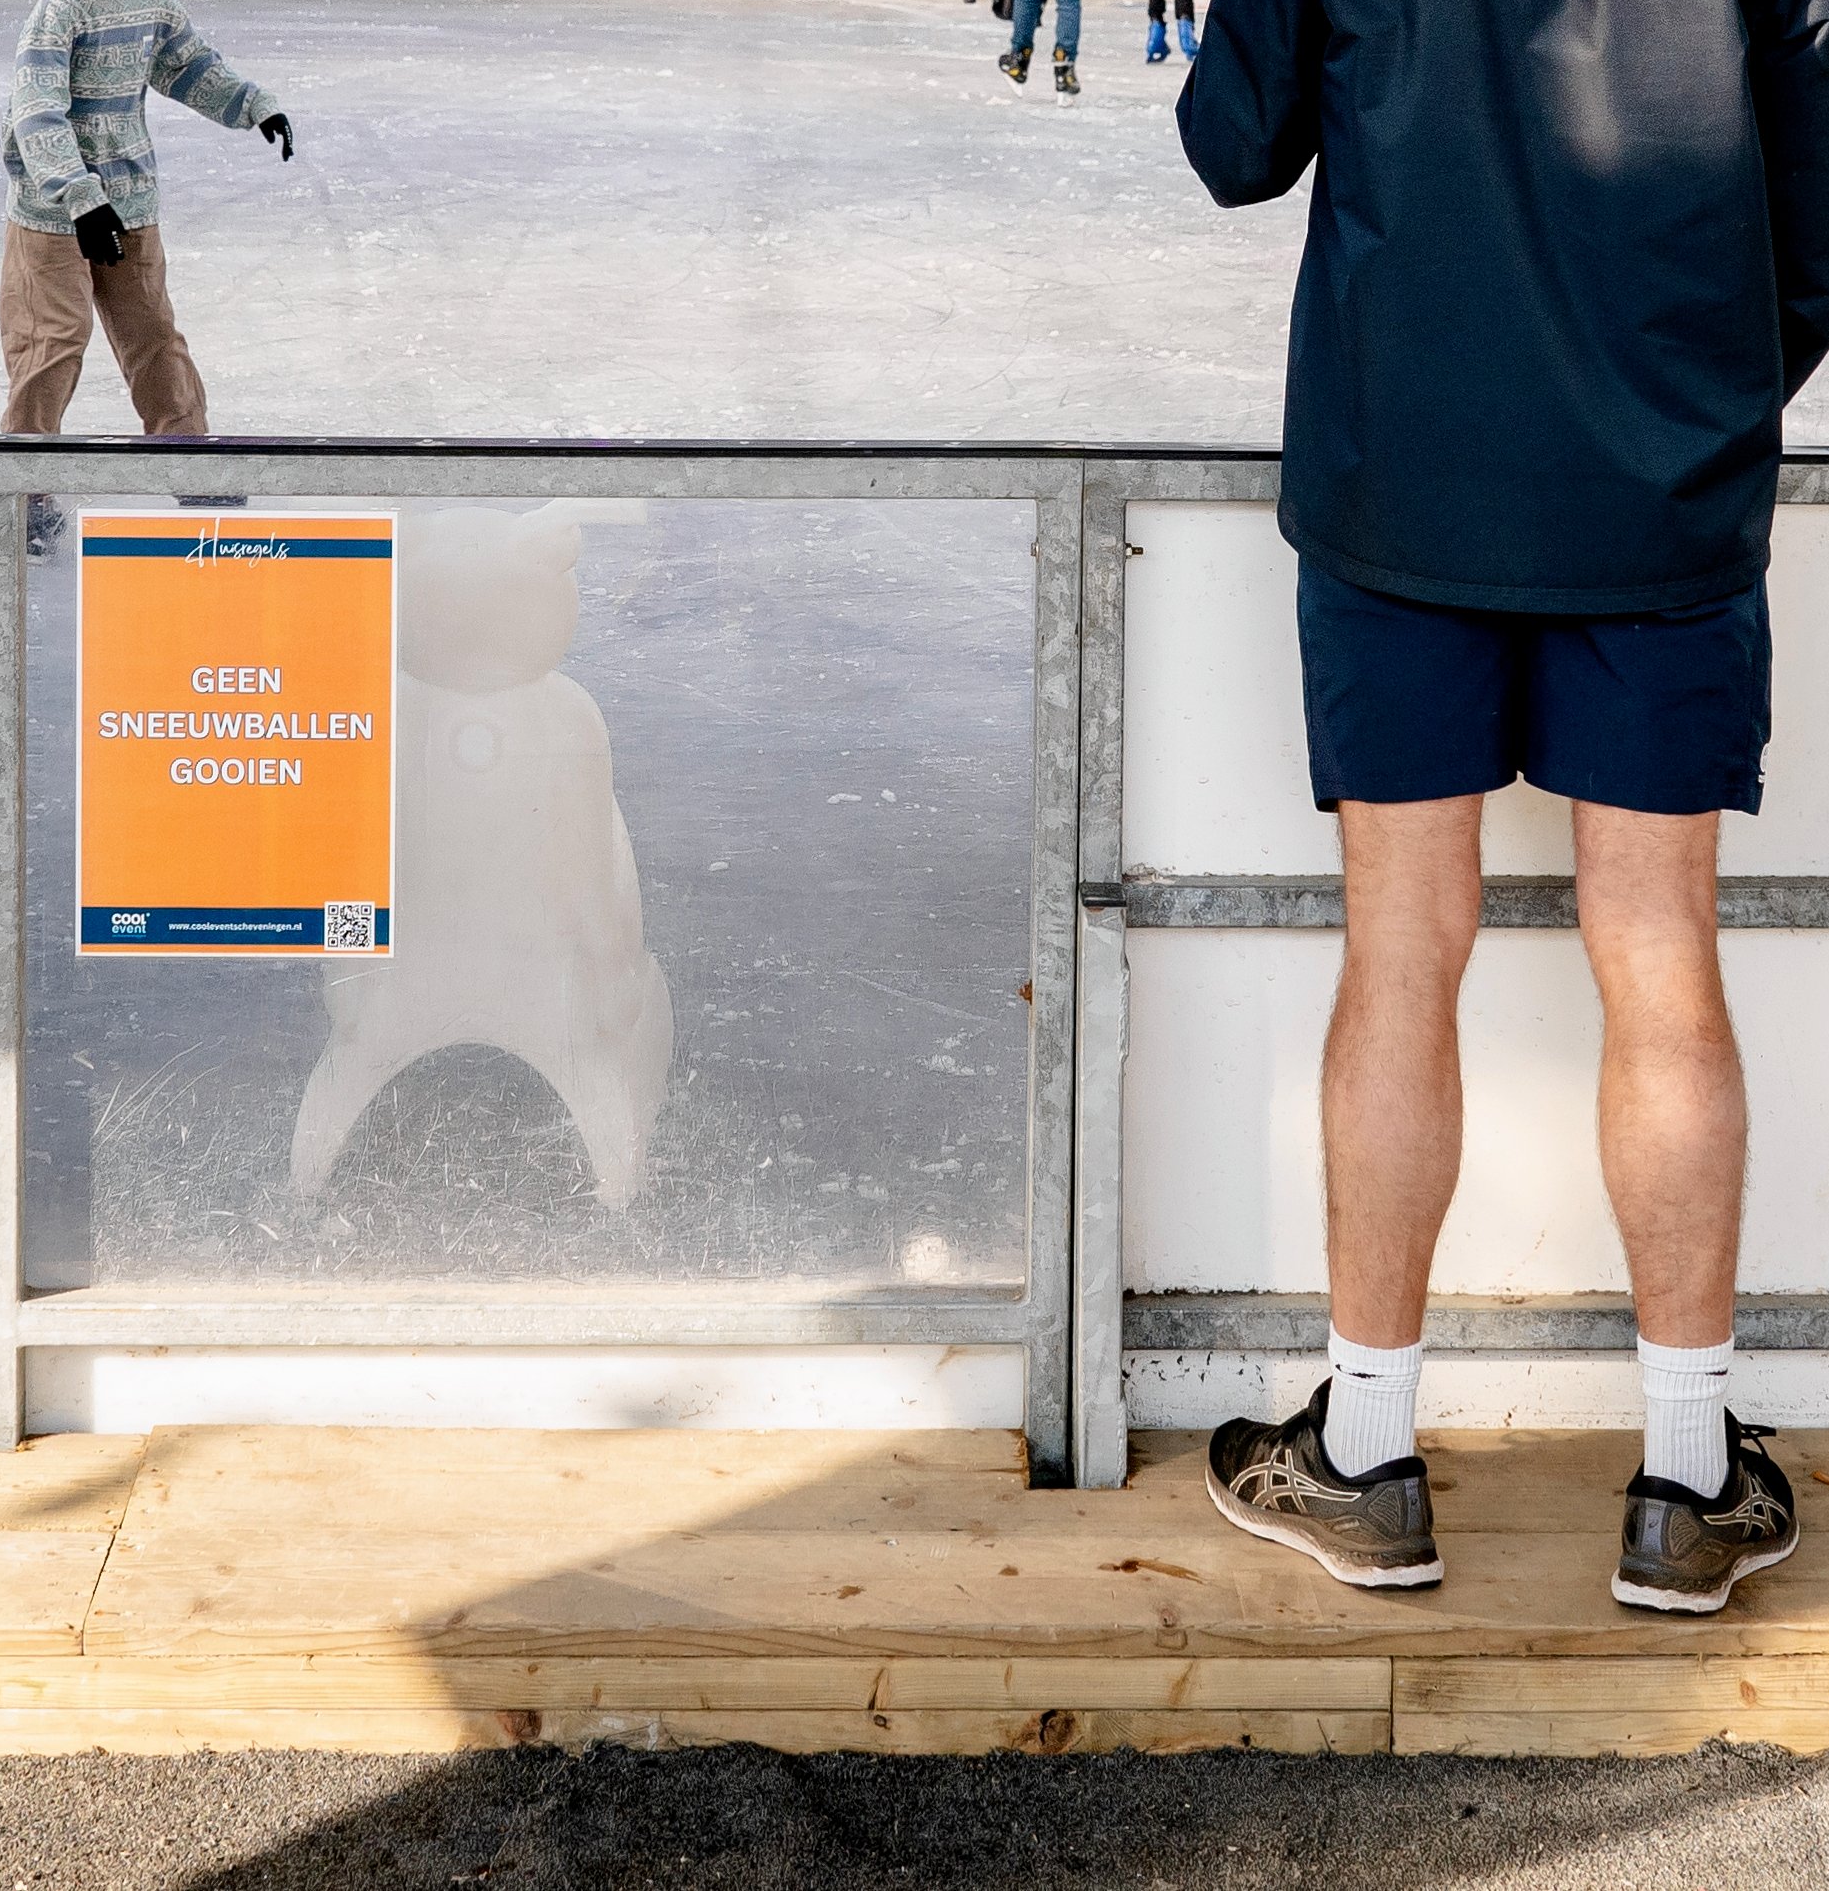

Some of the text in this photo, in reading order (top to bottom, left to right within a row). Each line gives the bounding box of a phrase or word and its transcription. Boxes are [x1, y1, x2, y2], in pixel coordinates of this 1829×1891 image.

[184, 516, 291, 569] Huisregels
[191, 666, 283, 694] GEEN
[98, 711, 373, 740] SNEEUWBALLEN
[169, 758, 303, 786] GOOIEN
[111, 912, 147, 925] COOL
[111, 925, 147, 934] event
[168, 922, 303, 933] www.cooleventscheveningen.nl
